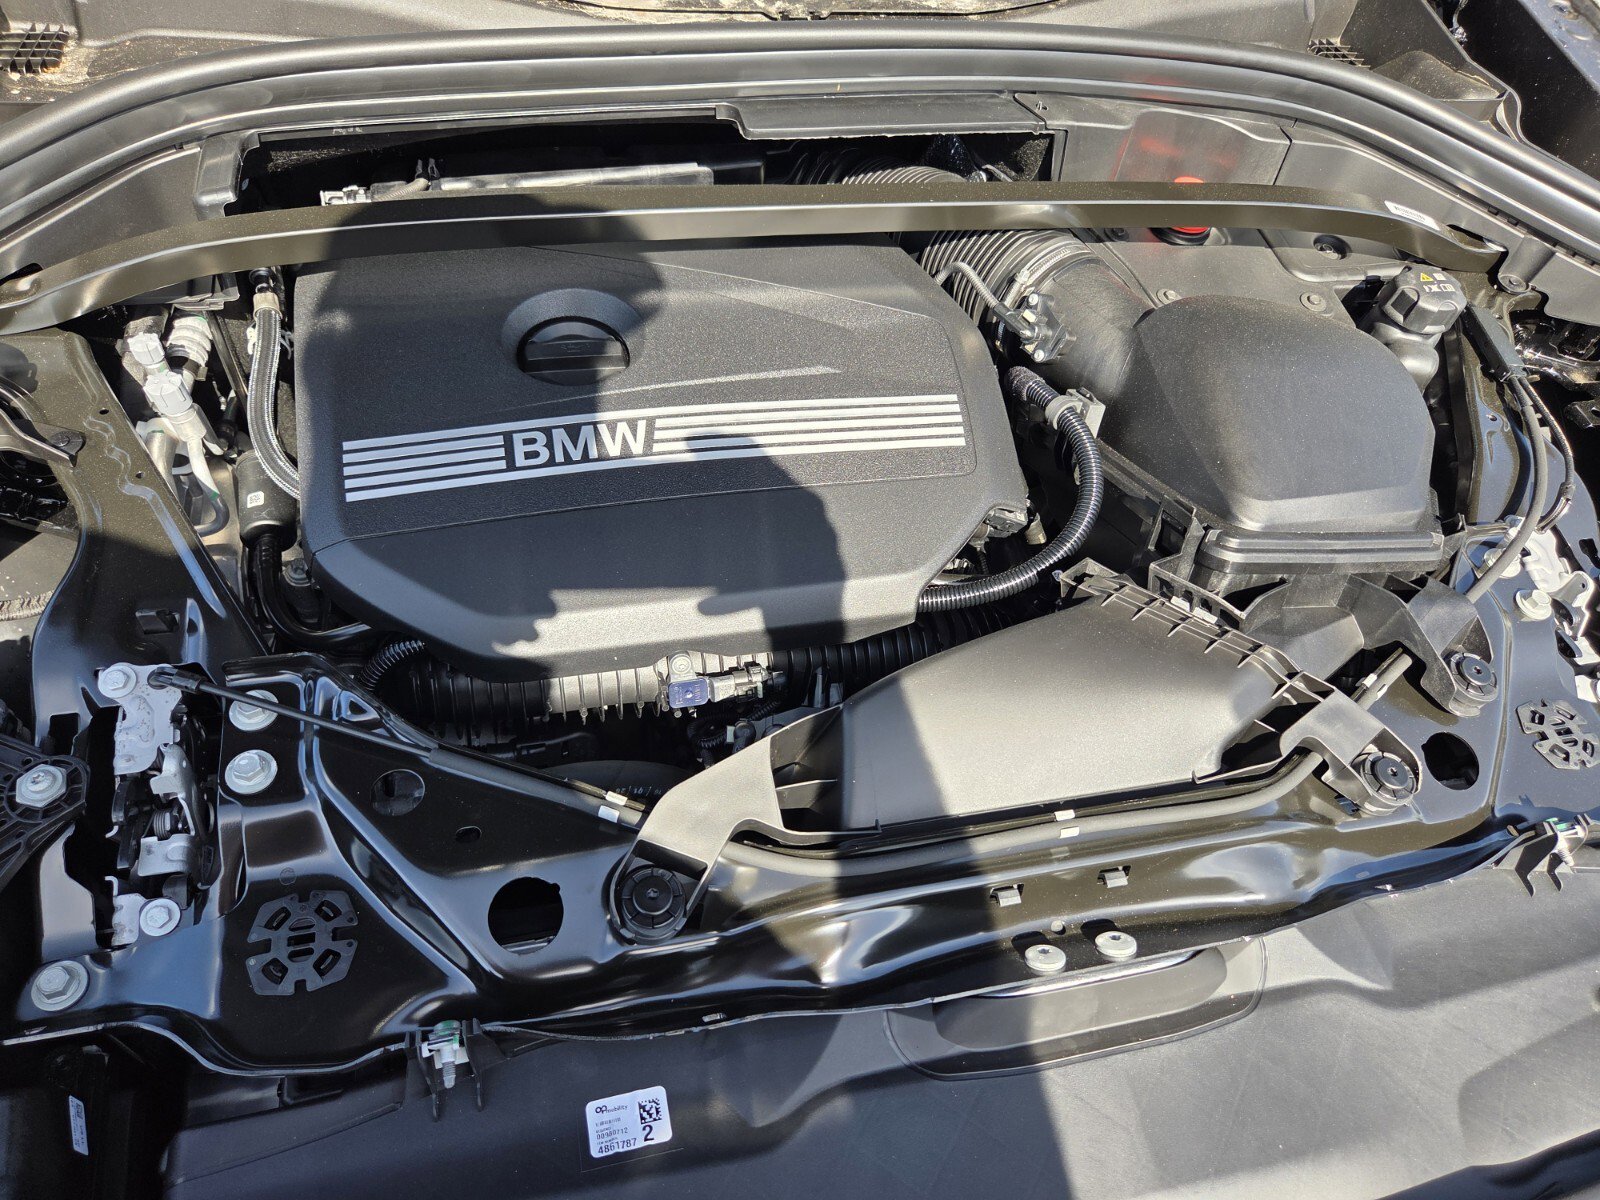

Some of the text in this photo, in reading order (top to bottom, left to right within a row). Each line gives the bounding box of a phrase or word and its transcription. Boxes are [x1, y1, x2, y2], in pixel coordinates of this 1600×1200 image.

[512, 420, 647, 467] BMW
[642, 1124, 655, 1142] 2
[598, 1137, 637, 1154] 4861787
